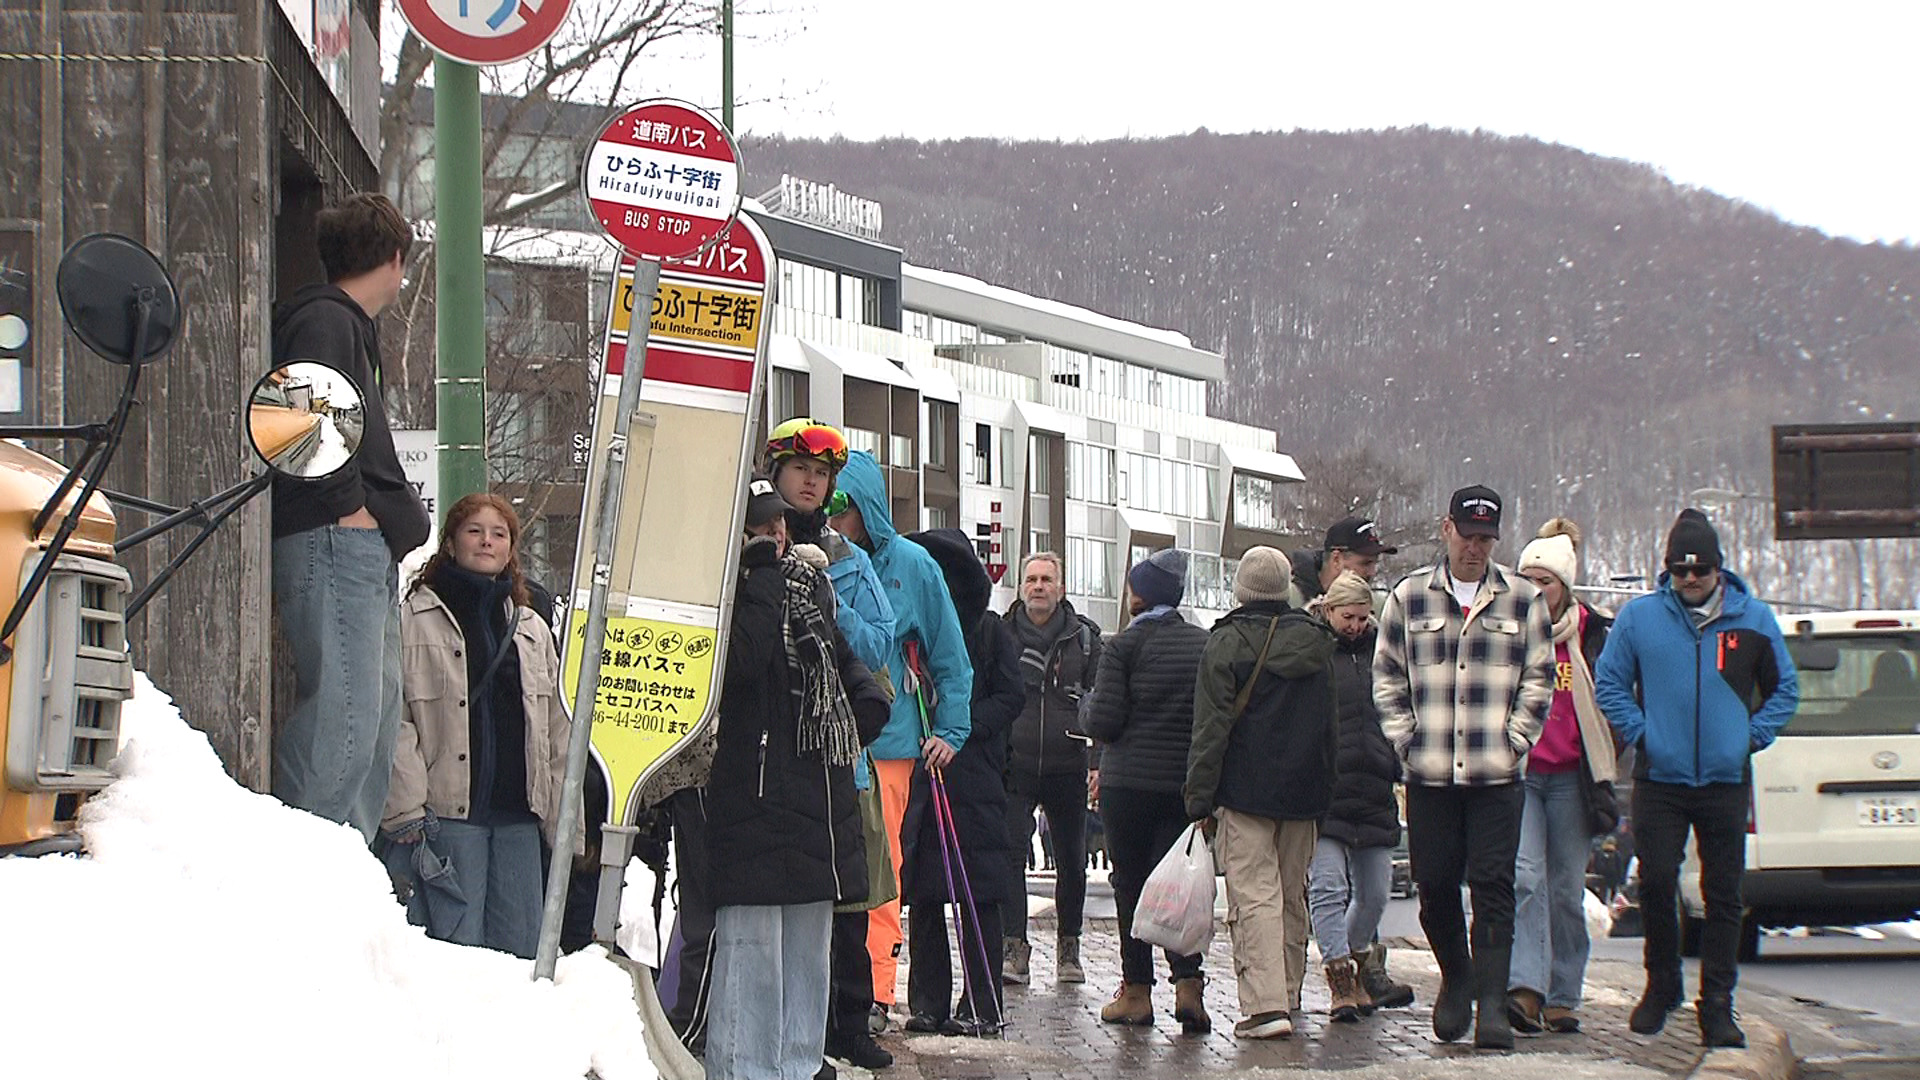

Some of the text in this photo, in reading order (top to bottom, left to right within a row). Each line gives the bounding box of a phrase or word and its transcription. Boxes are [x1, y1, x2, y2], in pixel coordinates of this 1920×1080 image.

[631, 119, 707, 149] 道南バス
[606, 155, 722, 191] ひらふ十字街
[599, 176, 721, 208] Hirafujyuujigai
[624, 210, 691, 236] BUS STOP
[669, 321, 742, 342] Intersection
[597, 674, 696, 700] のお問い合わせは
